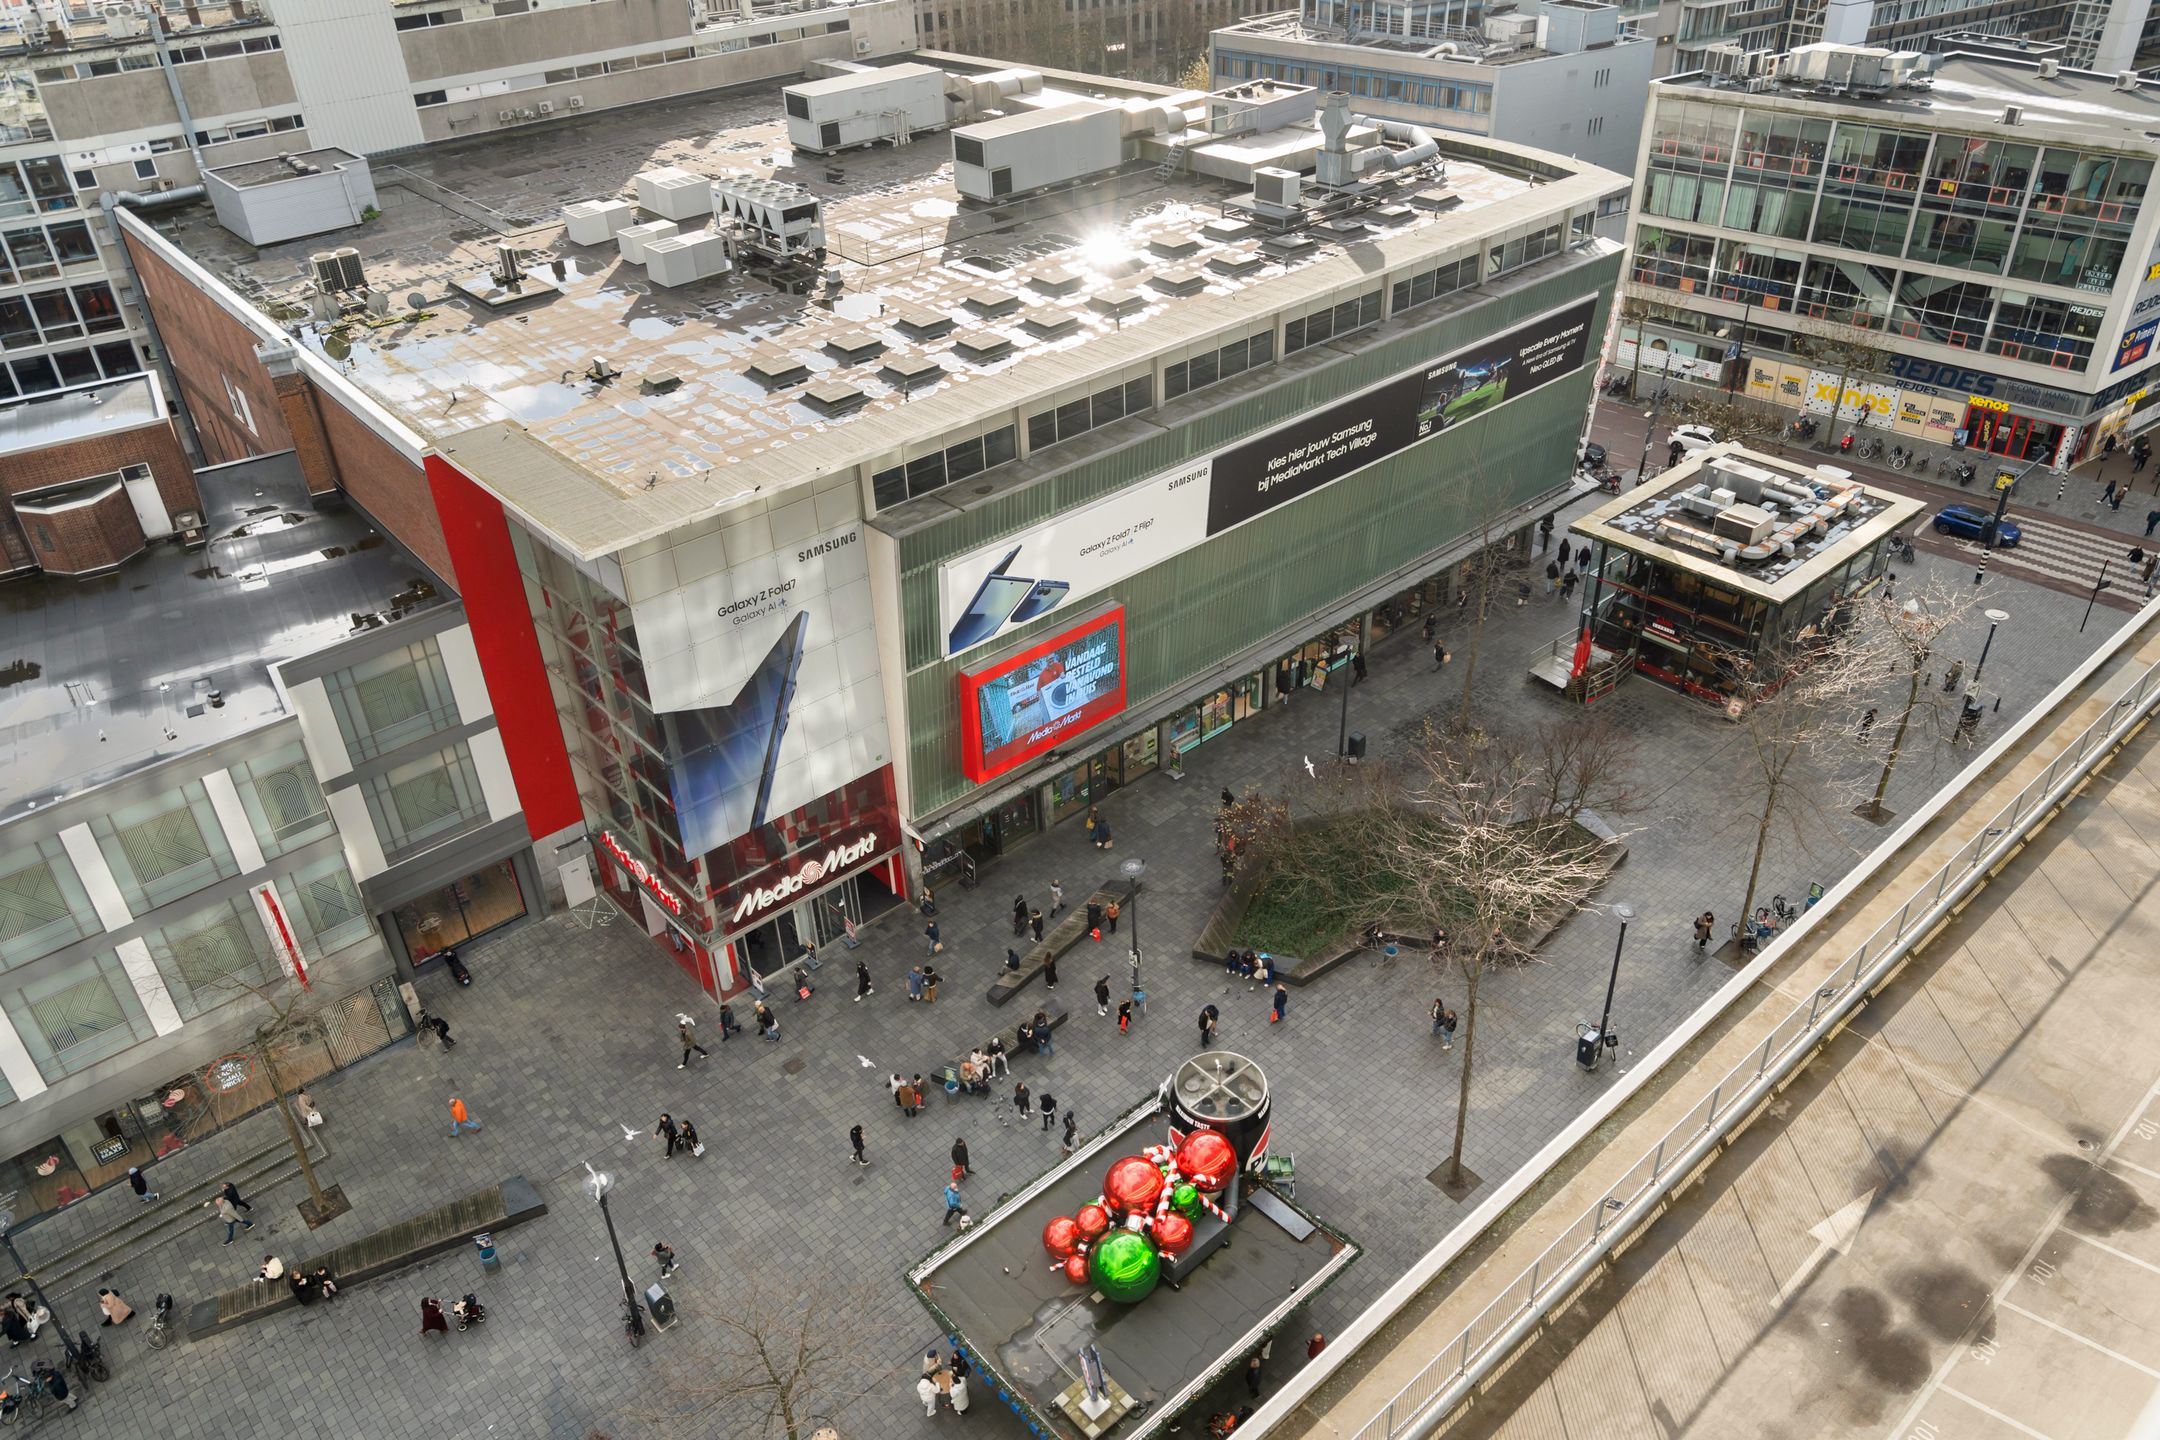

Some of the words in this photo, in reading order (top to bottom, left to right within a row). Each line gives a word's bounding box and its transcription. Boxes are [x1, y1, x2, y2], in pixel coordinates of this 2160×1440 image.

[2070, 305, 2105, 318] REJOES
[1520, 341, 1543, 357] Upscale
[1543, 334, 1560, 346] Every
[1560, 323, 1584, 339] Moment
[1428, 361, 1458, 380] SAMSUNG
[1896, 380, 1939, 396] REJOES
[1968, 395, 2010, 412] xenos
[1267, 457, 1287, 471] Kies
[1288, 447, 1307, 461] hier
[1306, 437, 1331, 457] jouw
[1331, 418, 1373, 444] Samsung
[1257, 477, 1270, 492] bij
[1270, 454, 1325, 486] MediaMarkt
[1326, 445, 1347, 461] Tech
[1348, 431, 1378, 451] Village
[1168, 467, 1208, 491] SAMSUNG
[798, 532, 857, 562] SAMSUNG
[1079, 541, 1107, 557] Galaxy
[1106, 536, 1112, 545] Z
[1112, 528, 1131, 542] Fold7
[1133, 525, 1139, 533] Z
[1138, 518, 1154, 531] Flip7
[1099, 544, 1121, 558] Galaxy
[717, 594, 759, 617] Galaxy
[760, 591, 767, 601] Z
[768, 578, 797, 598] Fold7
[732, 607, 766, 625] Galaxy
[768, 602, 777, 612] AI
[1065, 642, 1107, 671] VANDAAG
[1065, 662, 1114, 694] VANAVOND
[1027, 727, 1053, 745] Media
[1059, 710, 1082, 731] Markt
[733, 873, 803, 923] Media
[820, 831, 877, 877] Markt
[1194, 1120, 1211, 1130] TASTE
[2133, 1118, 2160, 1140] 102
[2027, 1259, 2057, 1287] 104
[1970, 1335, 2000, 1365] 105
[1908, 1419, 1940, 1440] 10
